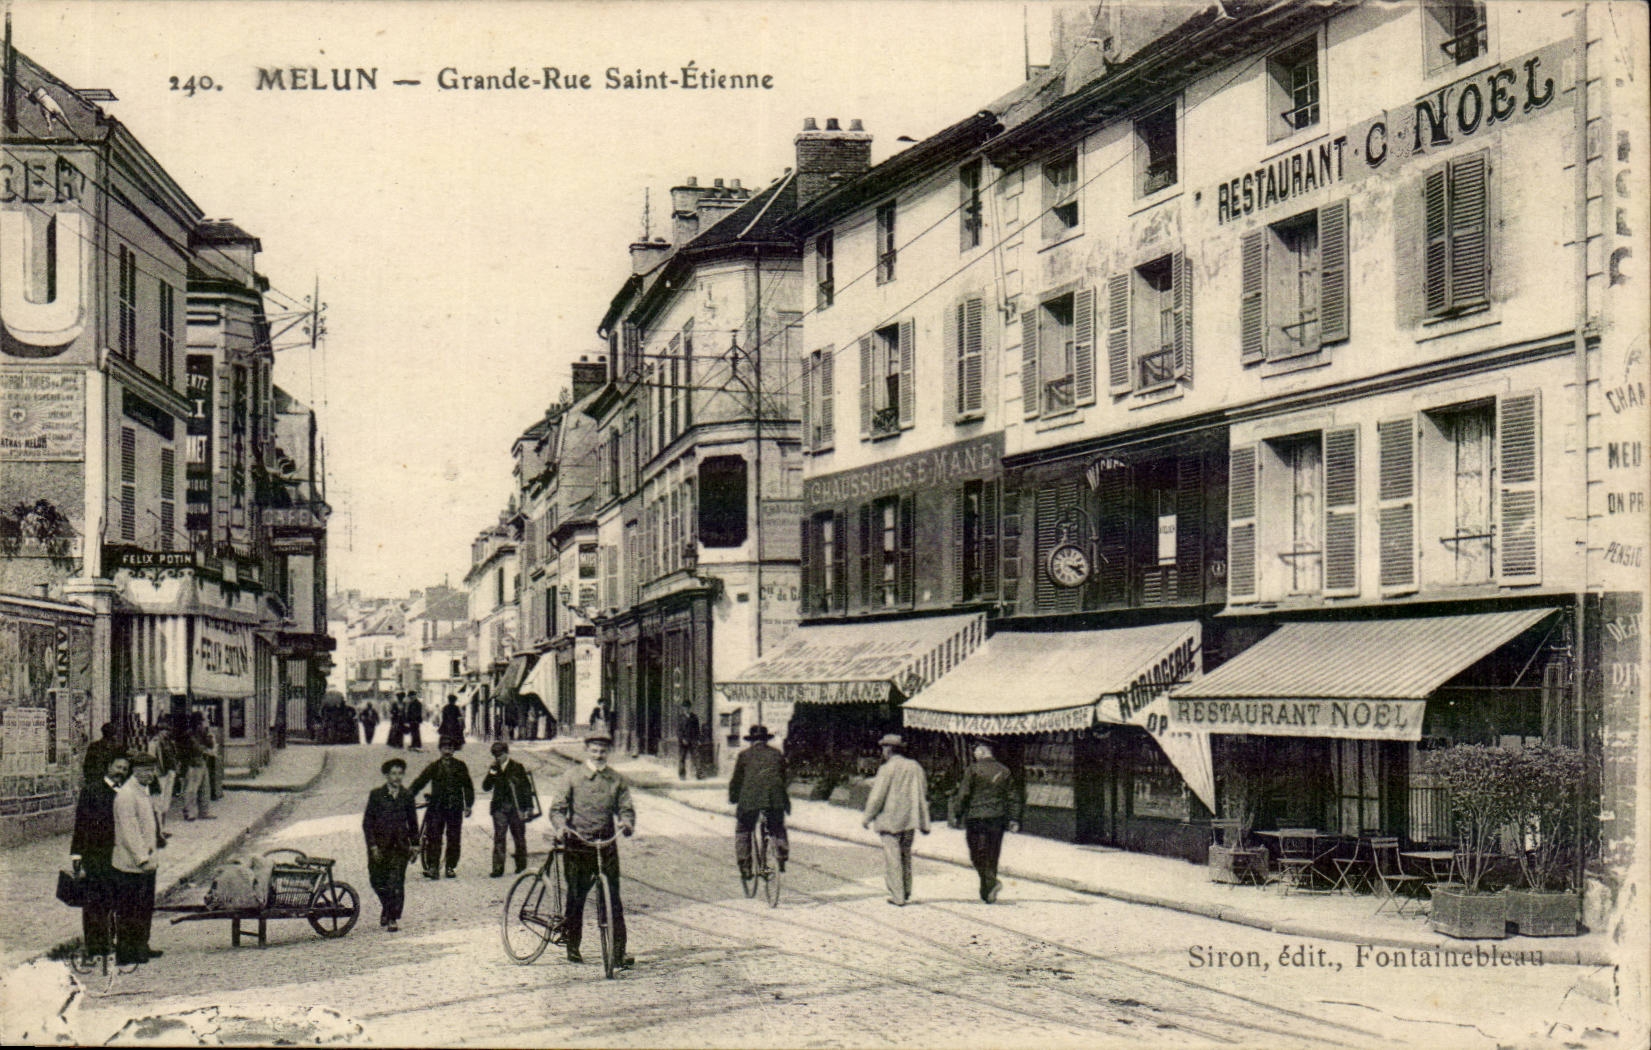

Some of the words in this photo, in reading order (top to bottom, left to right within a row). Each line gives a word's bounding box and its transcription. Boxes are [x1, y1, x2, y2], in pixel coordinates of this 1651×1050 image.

[1218, 135, 1348, 226] RESTAURANT
[1412, 56, 1554, 156] NOEL
[810, 458, 914, 505] CHAUSSURES
[122, 554, 154, 565] FELIX
[159, 554, 192, 565] POTIN
[1117, 636, 1195, 718] HORLOGERIE
[1177, 700, 1321, 728] RESTAURANT
[1330, 700, 1410, 730] NOEL
